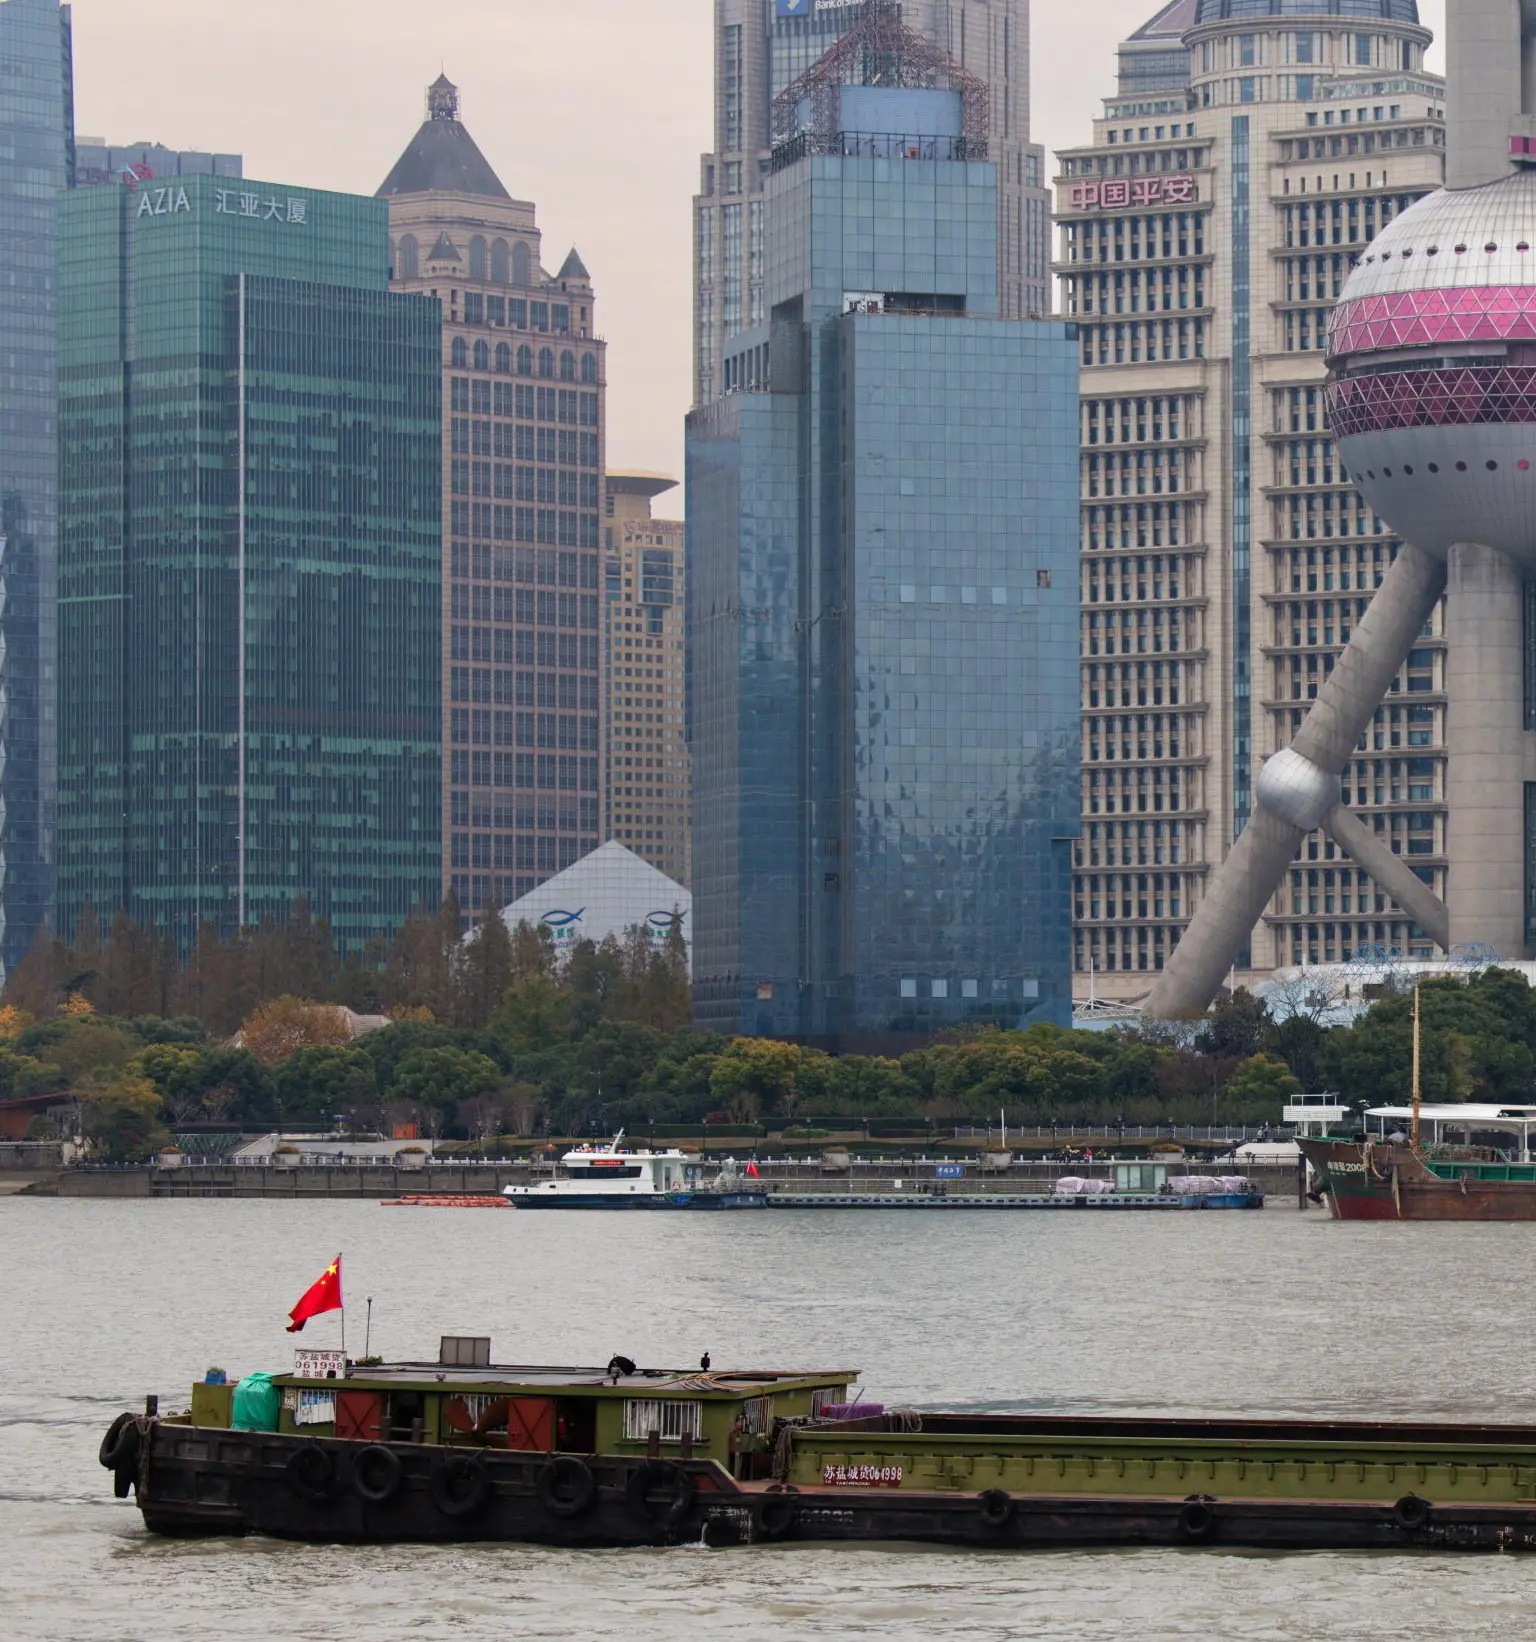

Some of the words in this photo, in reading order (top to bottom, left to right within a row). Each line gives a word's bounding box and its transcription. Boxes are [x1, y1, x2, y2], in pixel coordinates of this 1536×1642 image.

[815, 0, 837, 10] Bank
[137, 186, 191, 217] AZIA
[216, 187, 307, 225] 汇亚大厦
[1070, 174, 1194, 210] 中国平安
[295, 1361, 343, 1370] 061998
